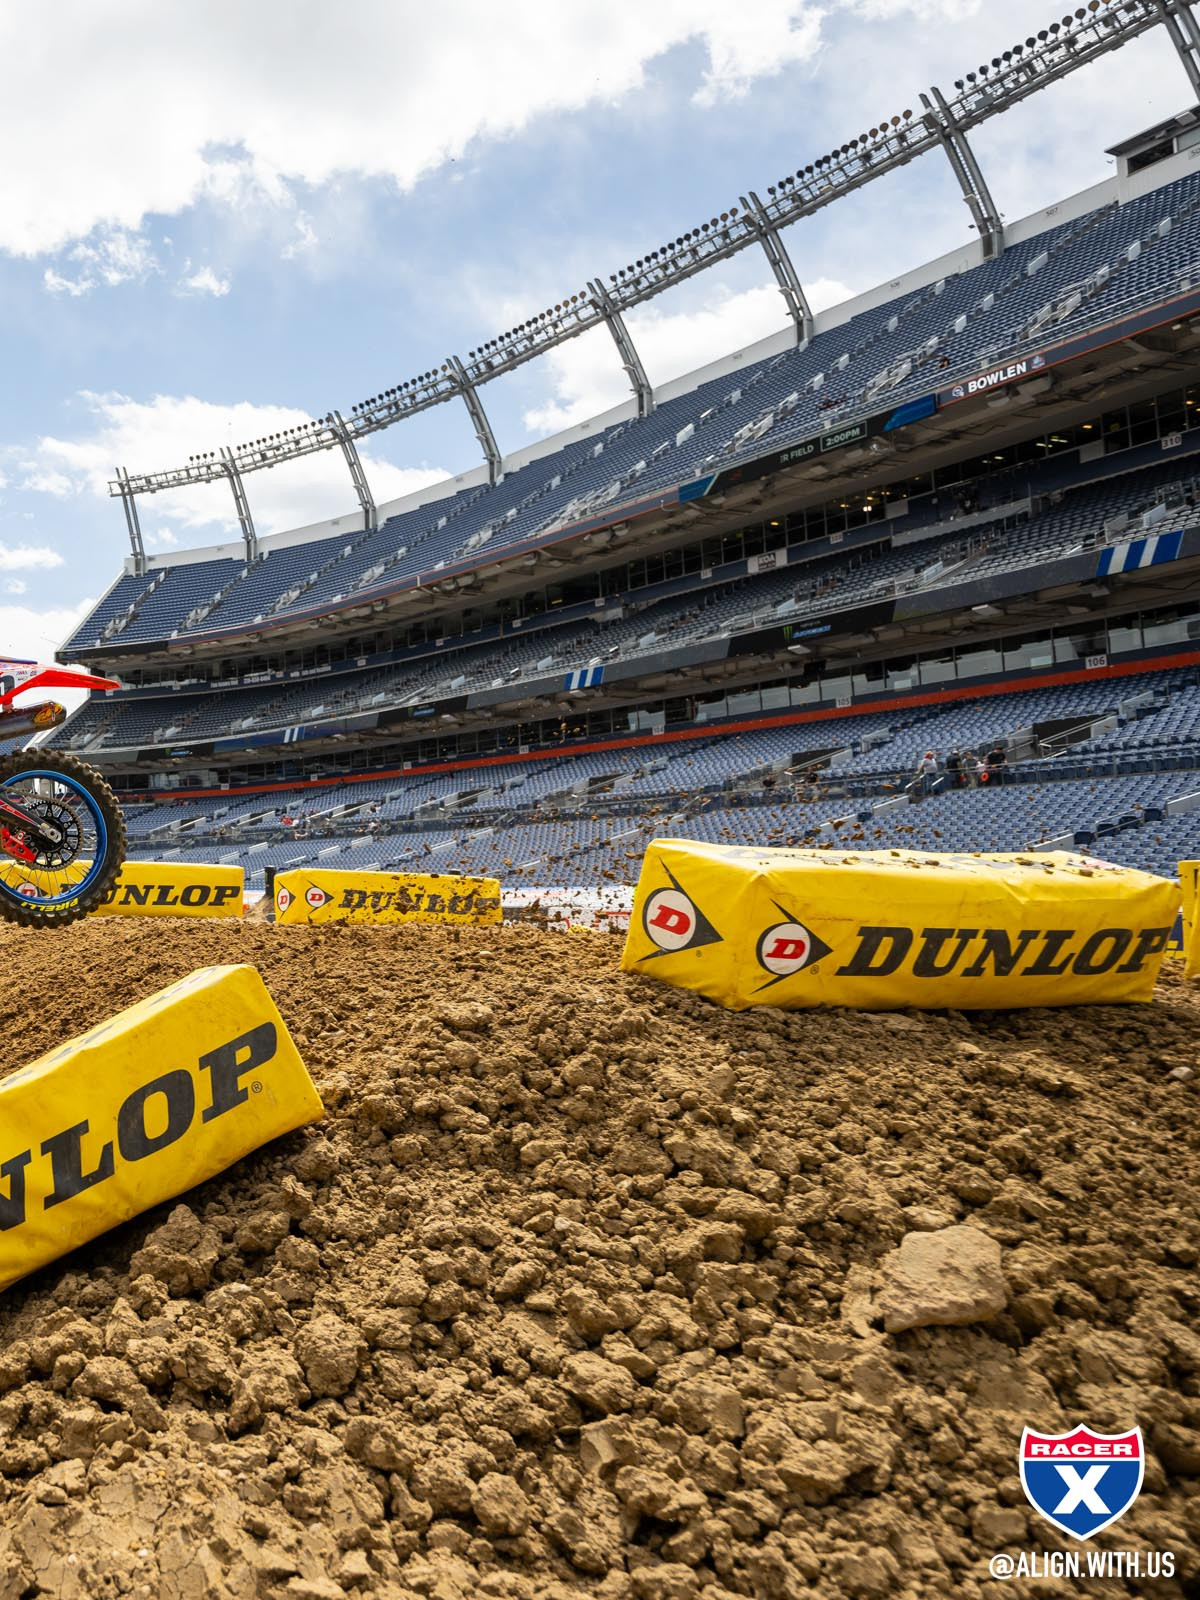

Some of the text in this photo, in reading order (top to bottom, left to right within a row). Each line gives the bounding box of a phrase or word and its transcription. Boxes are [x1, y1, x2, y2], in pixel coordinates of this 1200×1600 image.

[967, 361, 1028, 393] BOWLEN
[826, 427, 860, 446] 2:00PM
[1162, 437, 1181, 448] 310
[790, 444, 815, 460] FIELD
[1087, 656, 1105, 667] 106
[20, 897, 79, 912] PIRELLI
[60, 884, 241, 908] UNLOP
[278, 893, 290, 909] D
[309, 892, 326, 904] D
[649, 904, 692, 936] D
[765, 937, 806, 960] D
[835, 926, 1173, 977] DUNLOP
